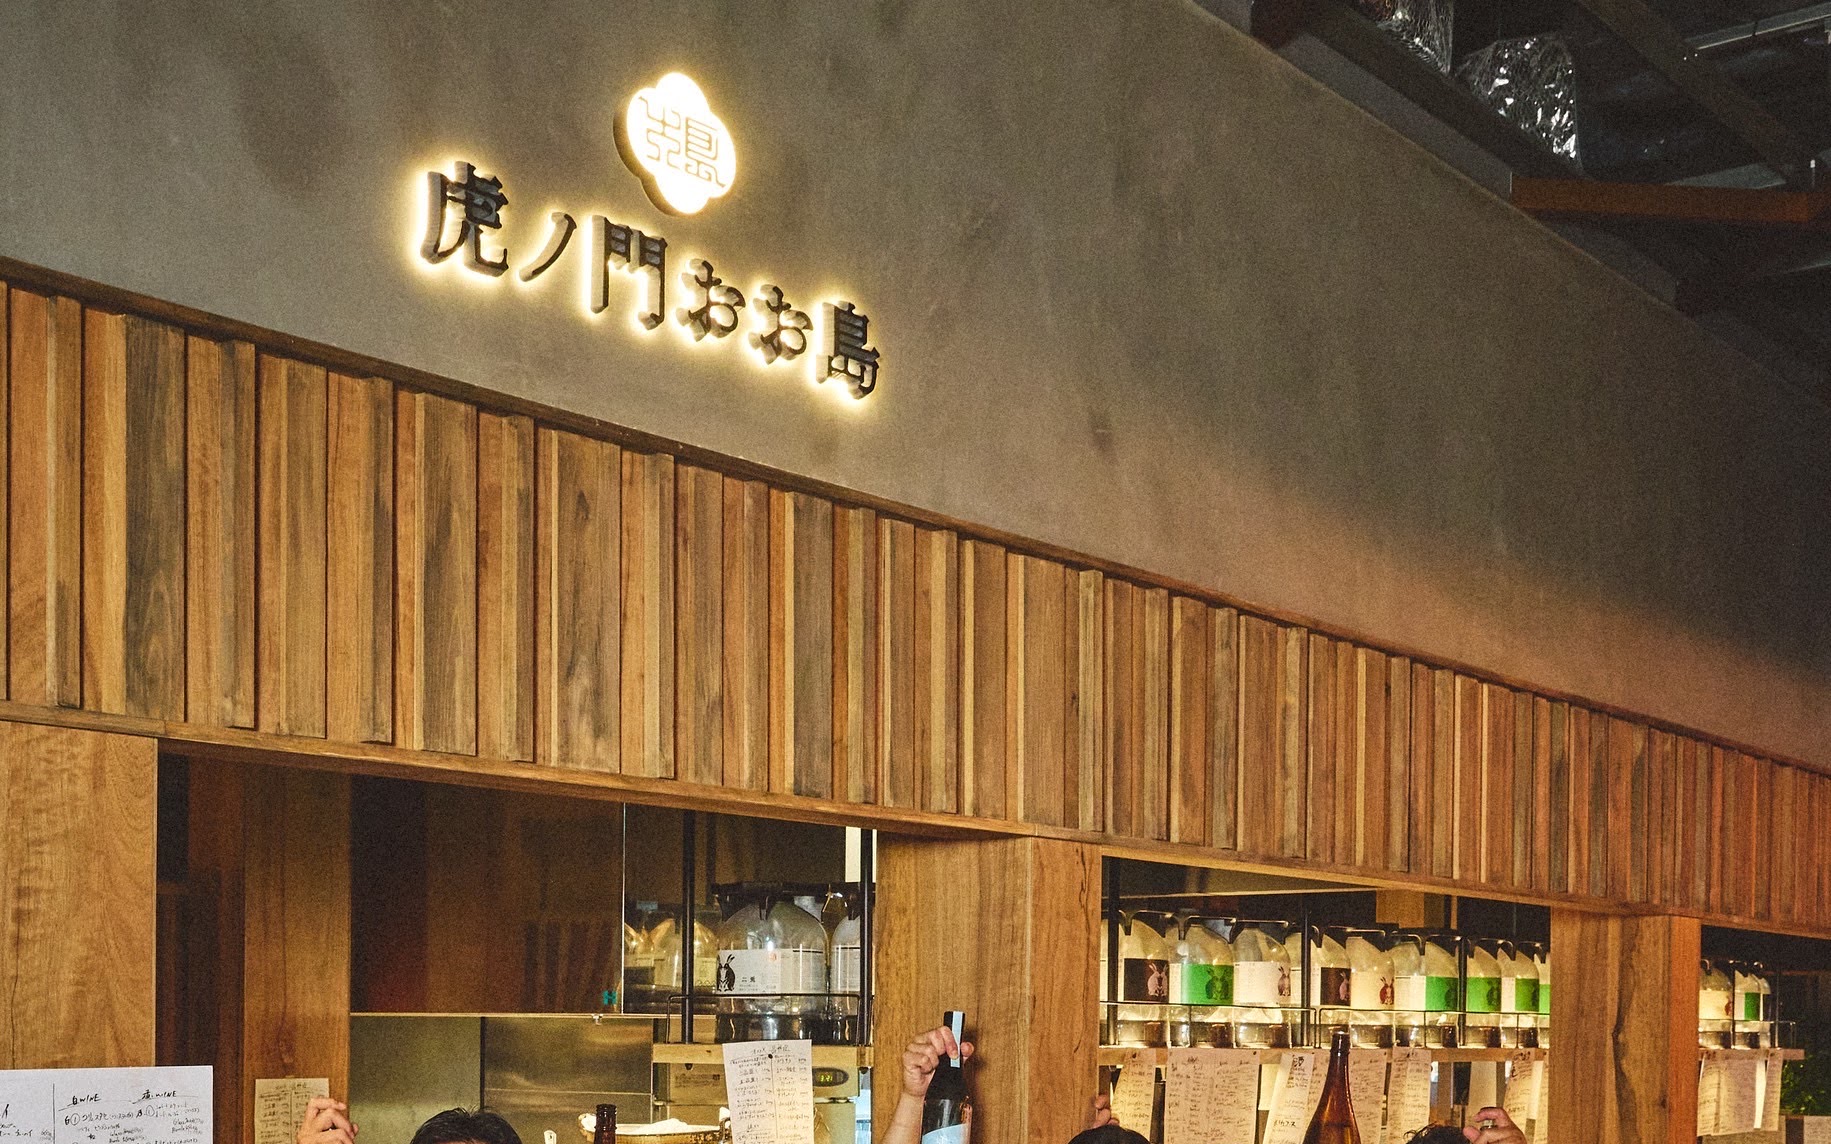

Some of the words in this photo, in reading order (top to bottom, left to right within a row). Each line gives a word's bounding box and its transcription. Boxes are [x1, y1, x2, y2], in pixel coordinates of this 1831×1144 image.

[420, 161, 881, 399] 虎ノ門おお島
